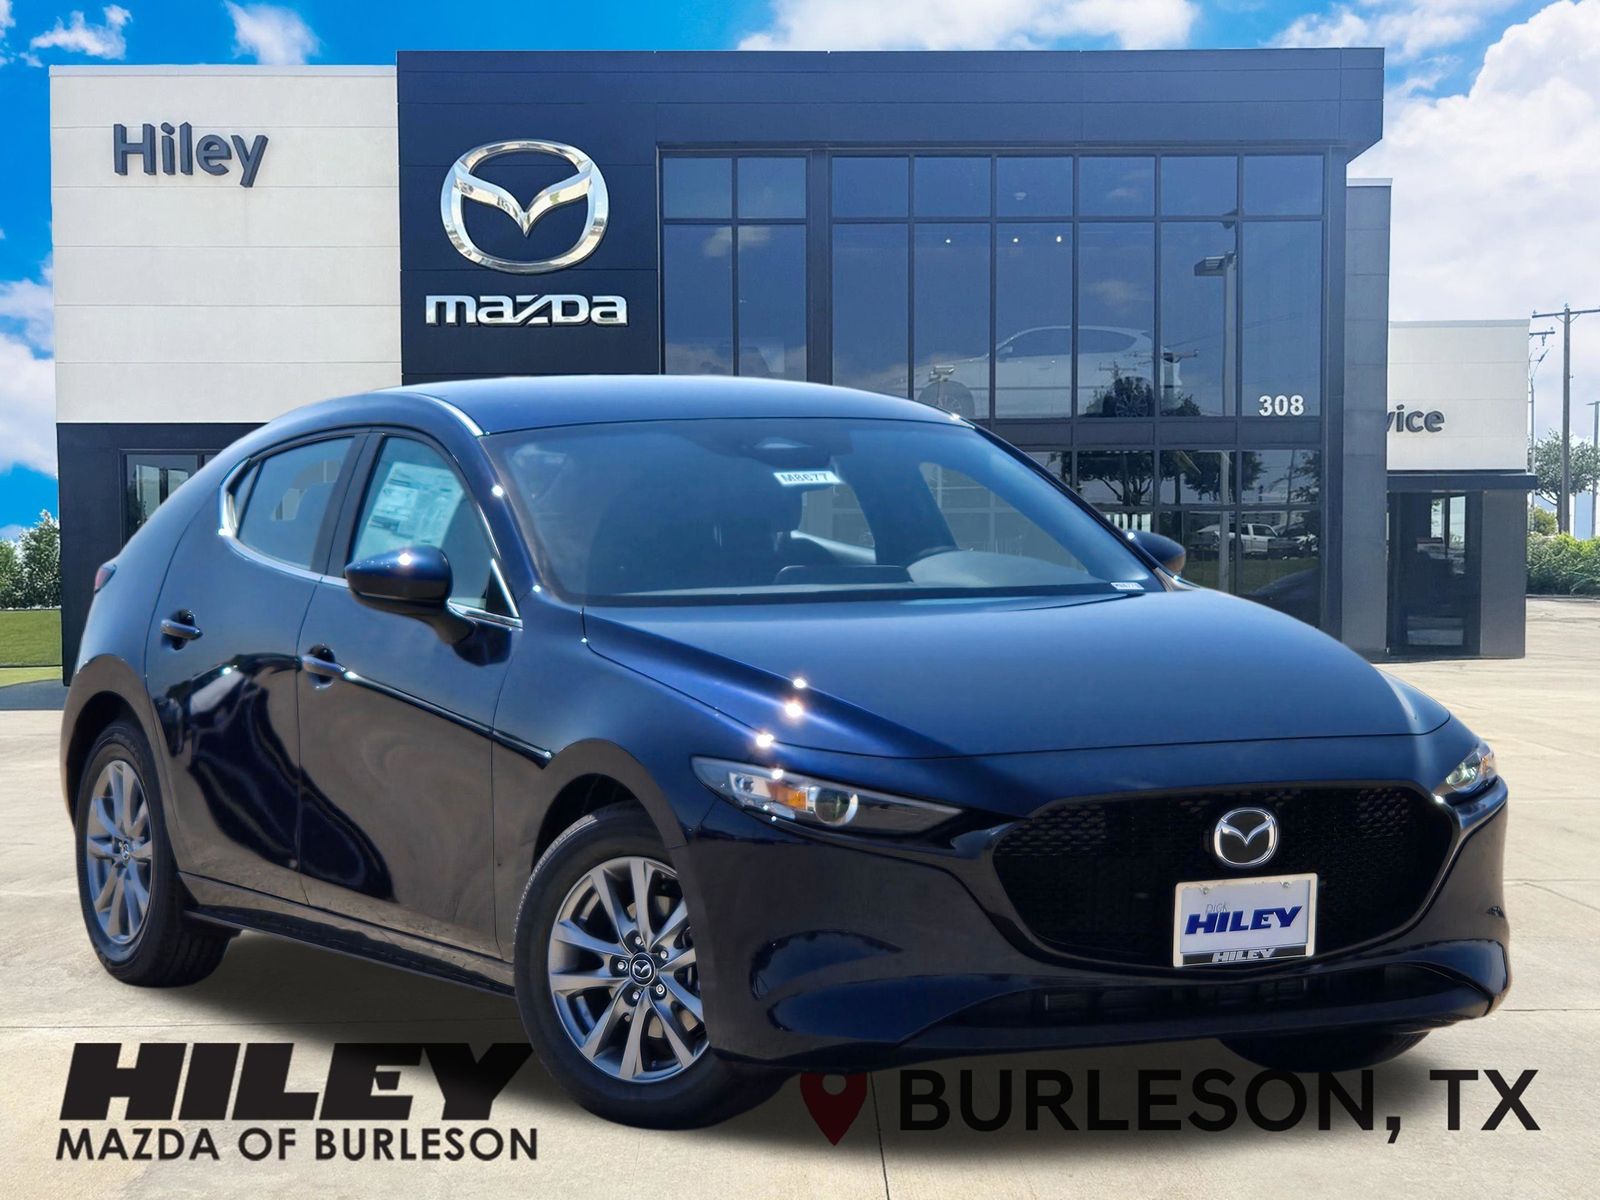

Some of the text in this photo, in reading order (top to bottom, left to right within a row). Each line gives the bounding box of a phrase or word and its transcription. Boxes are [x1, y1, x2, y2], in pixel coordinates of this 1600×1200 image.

[113, 121, 269, 188] Hiley
[1258, 395, 1305, 417] 308
[1184, 905, 1303, 935] HILEY
[1211, 947, 1276, 963] HILEY
